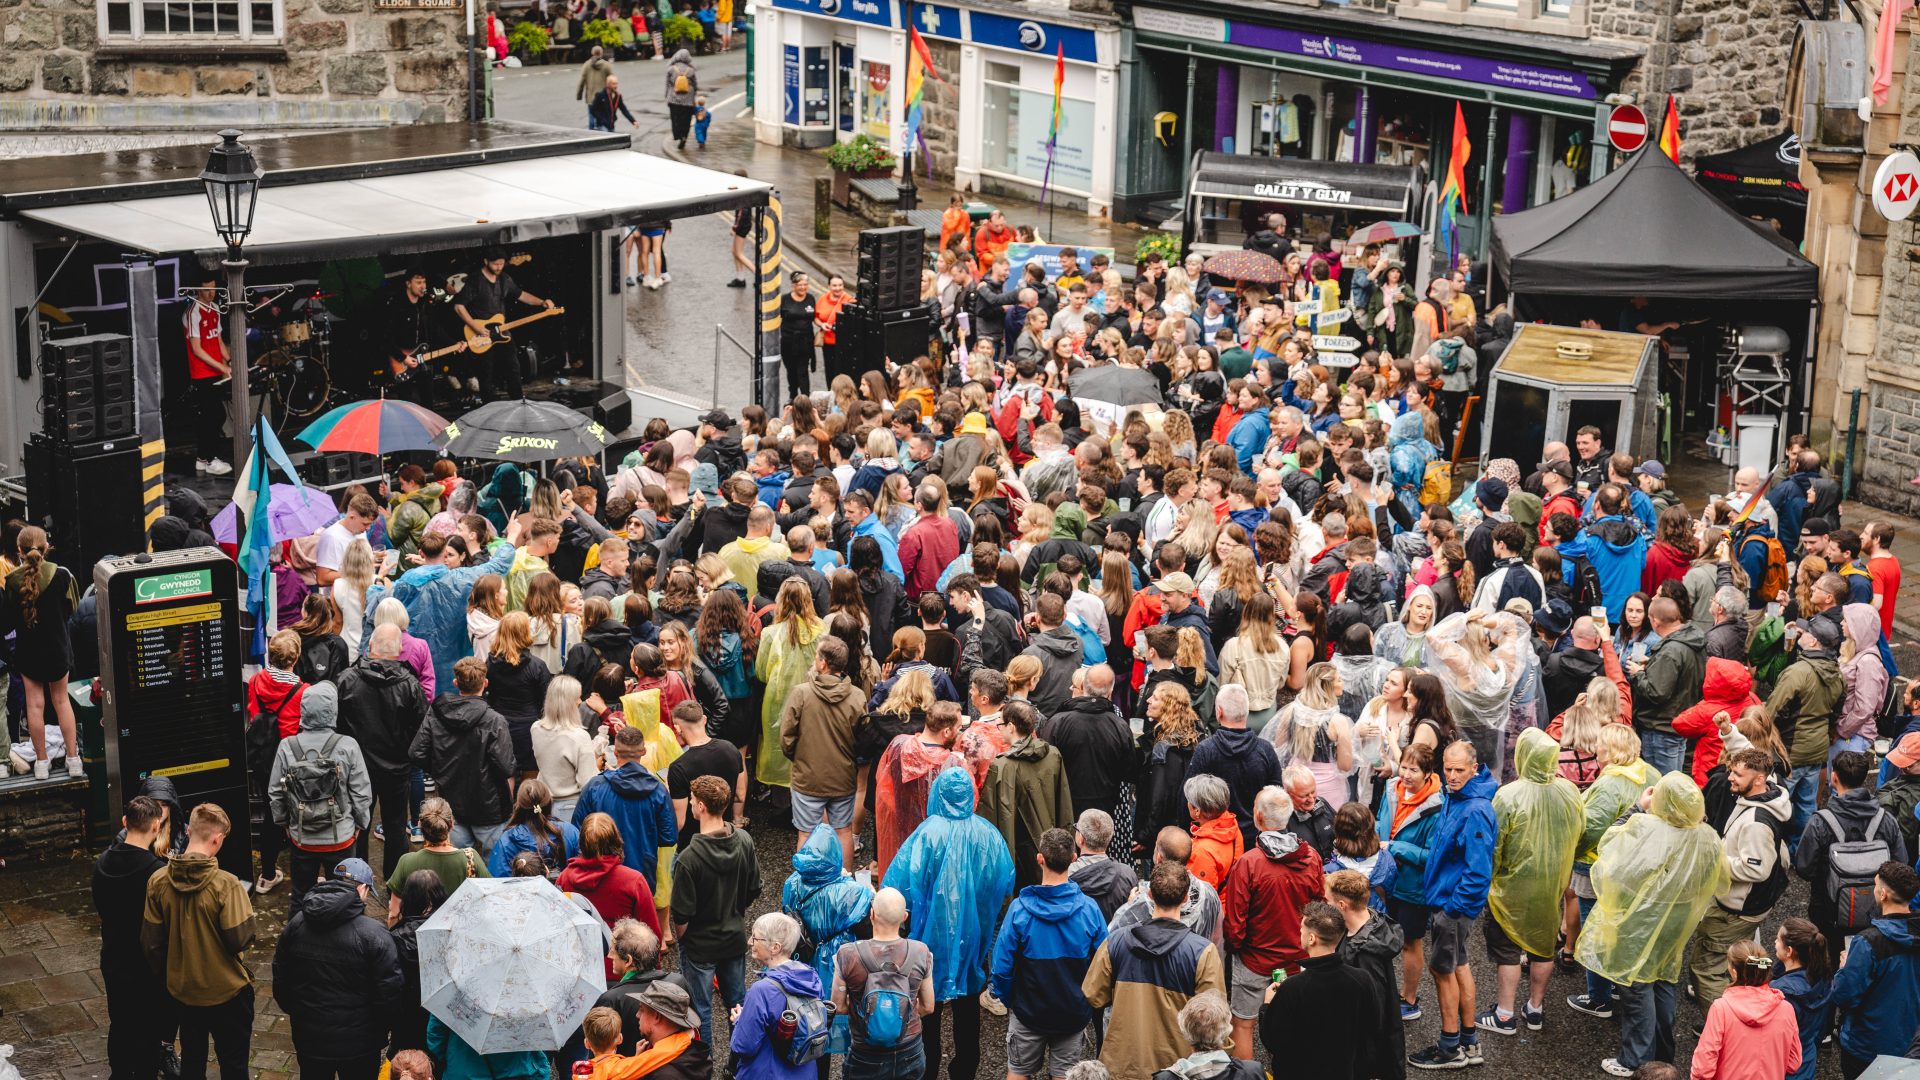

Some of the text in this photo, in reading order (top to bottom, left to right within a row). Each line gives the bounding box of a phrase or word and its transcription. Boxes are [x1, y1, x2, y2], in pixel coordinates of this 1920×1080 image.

[1743, 176, 1756, 184] JERK
[1254, 183, 1352, 203] GALLT Y GLYN
[1313, 336, 1357, 347] Y TORRENT
[1332, 354, 1353, 364] KEYS
[496, 435, 558, 455] SRIXON
[174, 572, 201, 581] CYNGOR
[160, 579, 201, 590] GWYNEDD
[173, 586, 202, 595] COUNCIL
[151, 611, 163, 619] High
[144, 649, 171, 657] Aberystwyth
[145, 671, 172, 680] Aberystwyth
[146, 679, 170, 688] Caernarfon
